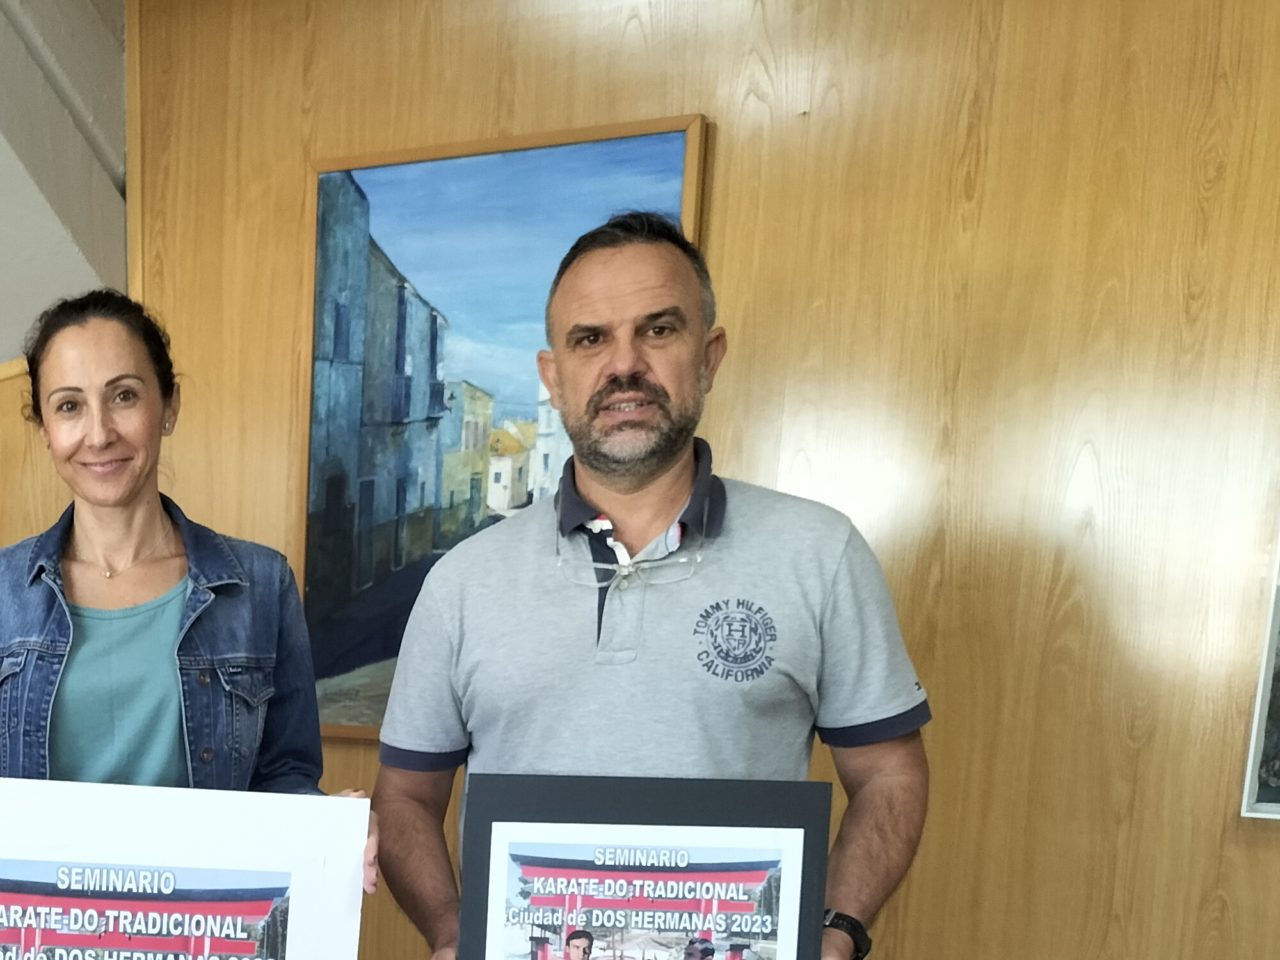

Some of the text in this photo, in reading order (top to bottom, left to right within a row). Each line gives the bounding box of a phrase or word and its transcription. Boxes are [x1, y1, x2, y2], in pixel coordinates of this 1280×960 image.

[693, 598, 777, 642] TOMMY HILFIGER
[696, 650, 775, 683] CALIFORNIA
[594, 849, 688, 867] SEMINARIO
[57, 868, 174, 894] SEMINARIO
[533, 877, 748, 900] KARATE-DO TRADICIONAL
[105, 910, 247, 939] TRADICIONAL
[509, 908, 772, 933] Ciudad de DOS HERMANAS 2023
